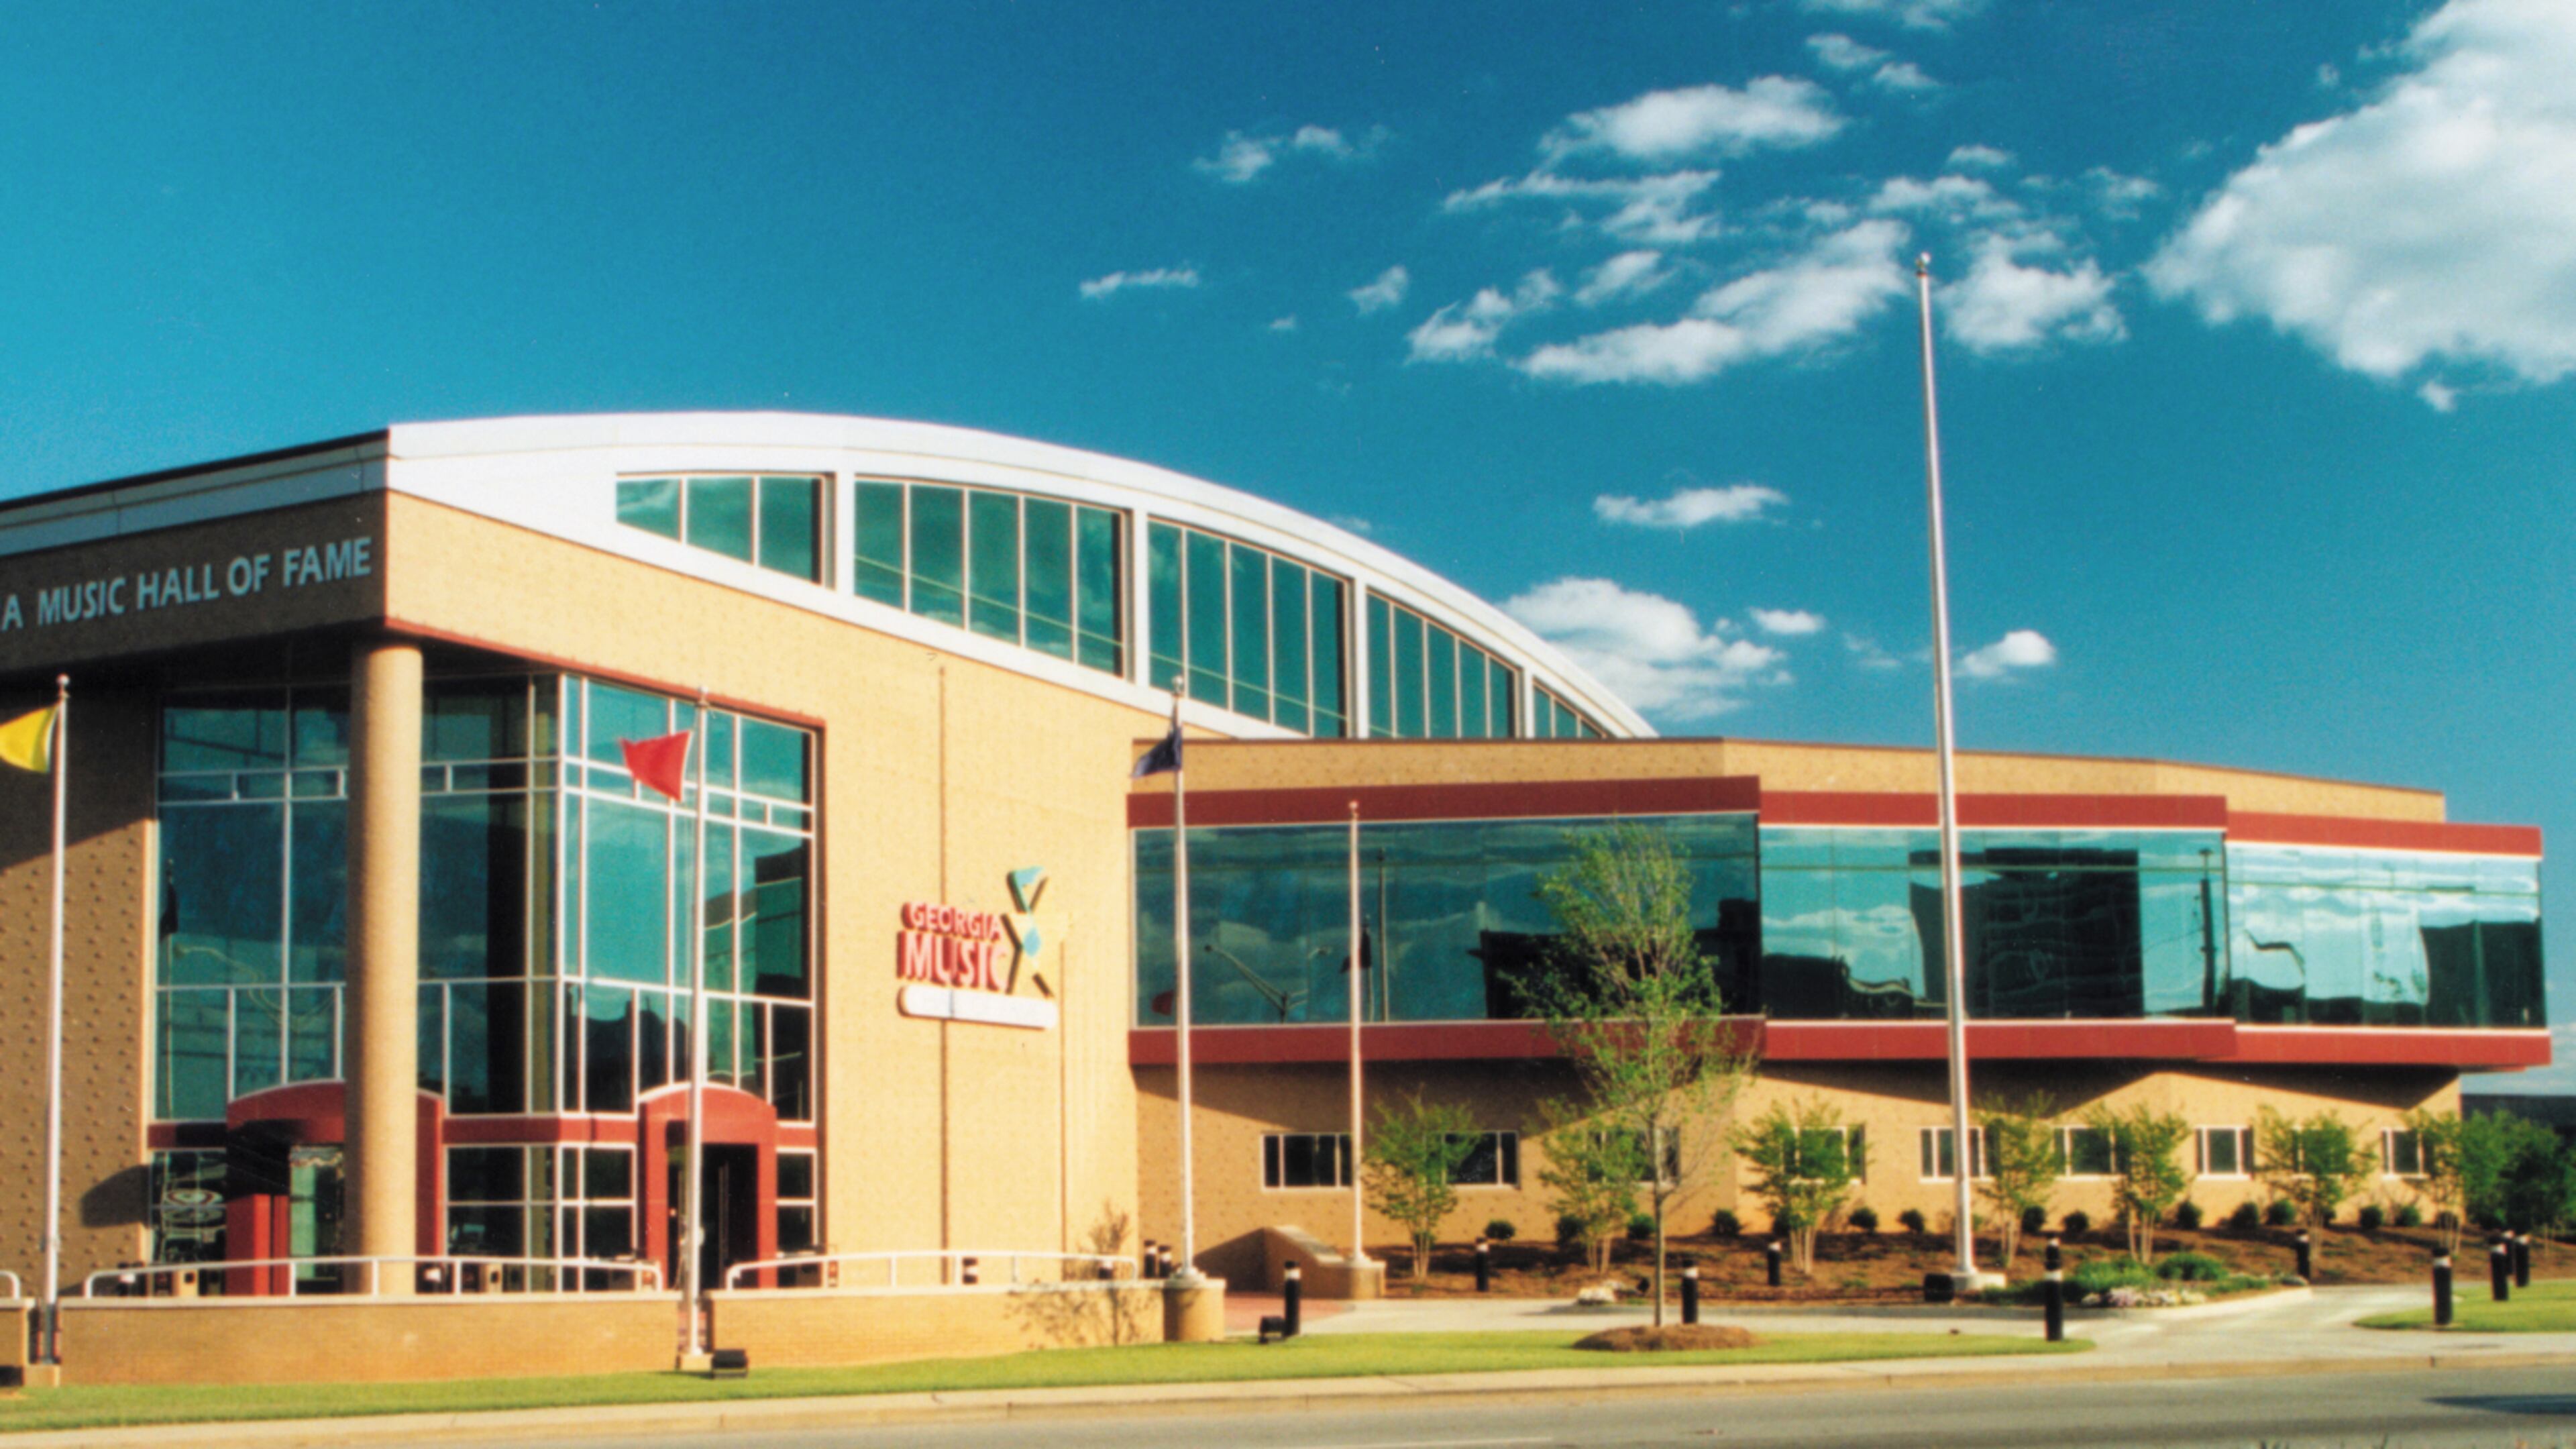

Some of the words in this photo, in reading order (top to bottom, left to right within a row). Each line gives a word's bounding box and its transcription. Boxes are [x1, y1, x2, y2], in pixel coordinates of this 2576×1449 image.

[1, 594, 24, 631] A
[38, 577, 126, 626] MUSIC
[137, 564, 219, 610] HALL
[227, 554, 270, 596] OF
[282, 537, 372, 587] FAME
[901, 903, 1002, 943] GEORGIA
[896, 930, 1008, 991] MUSIC
